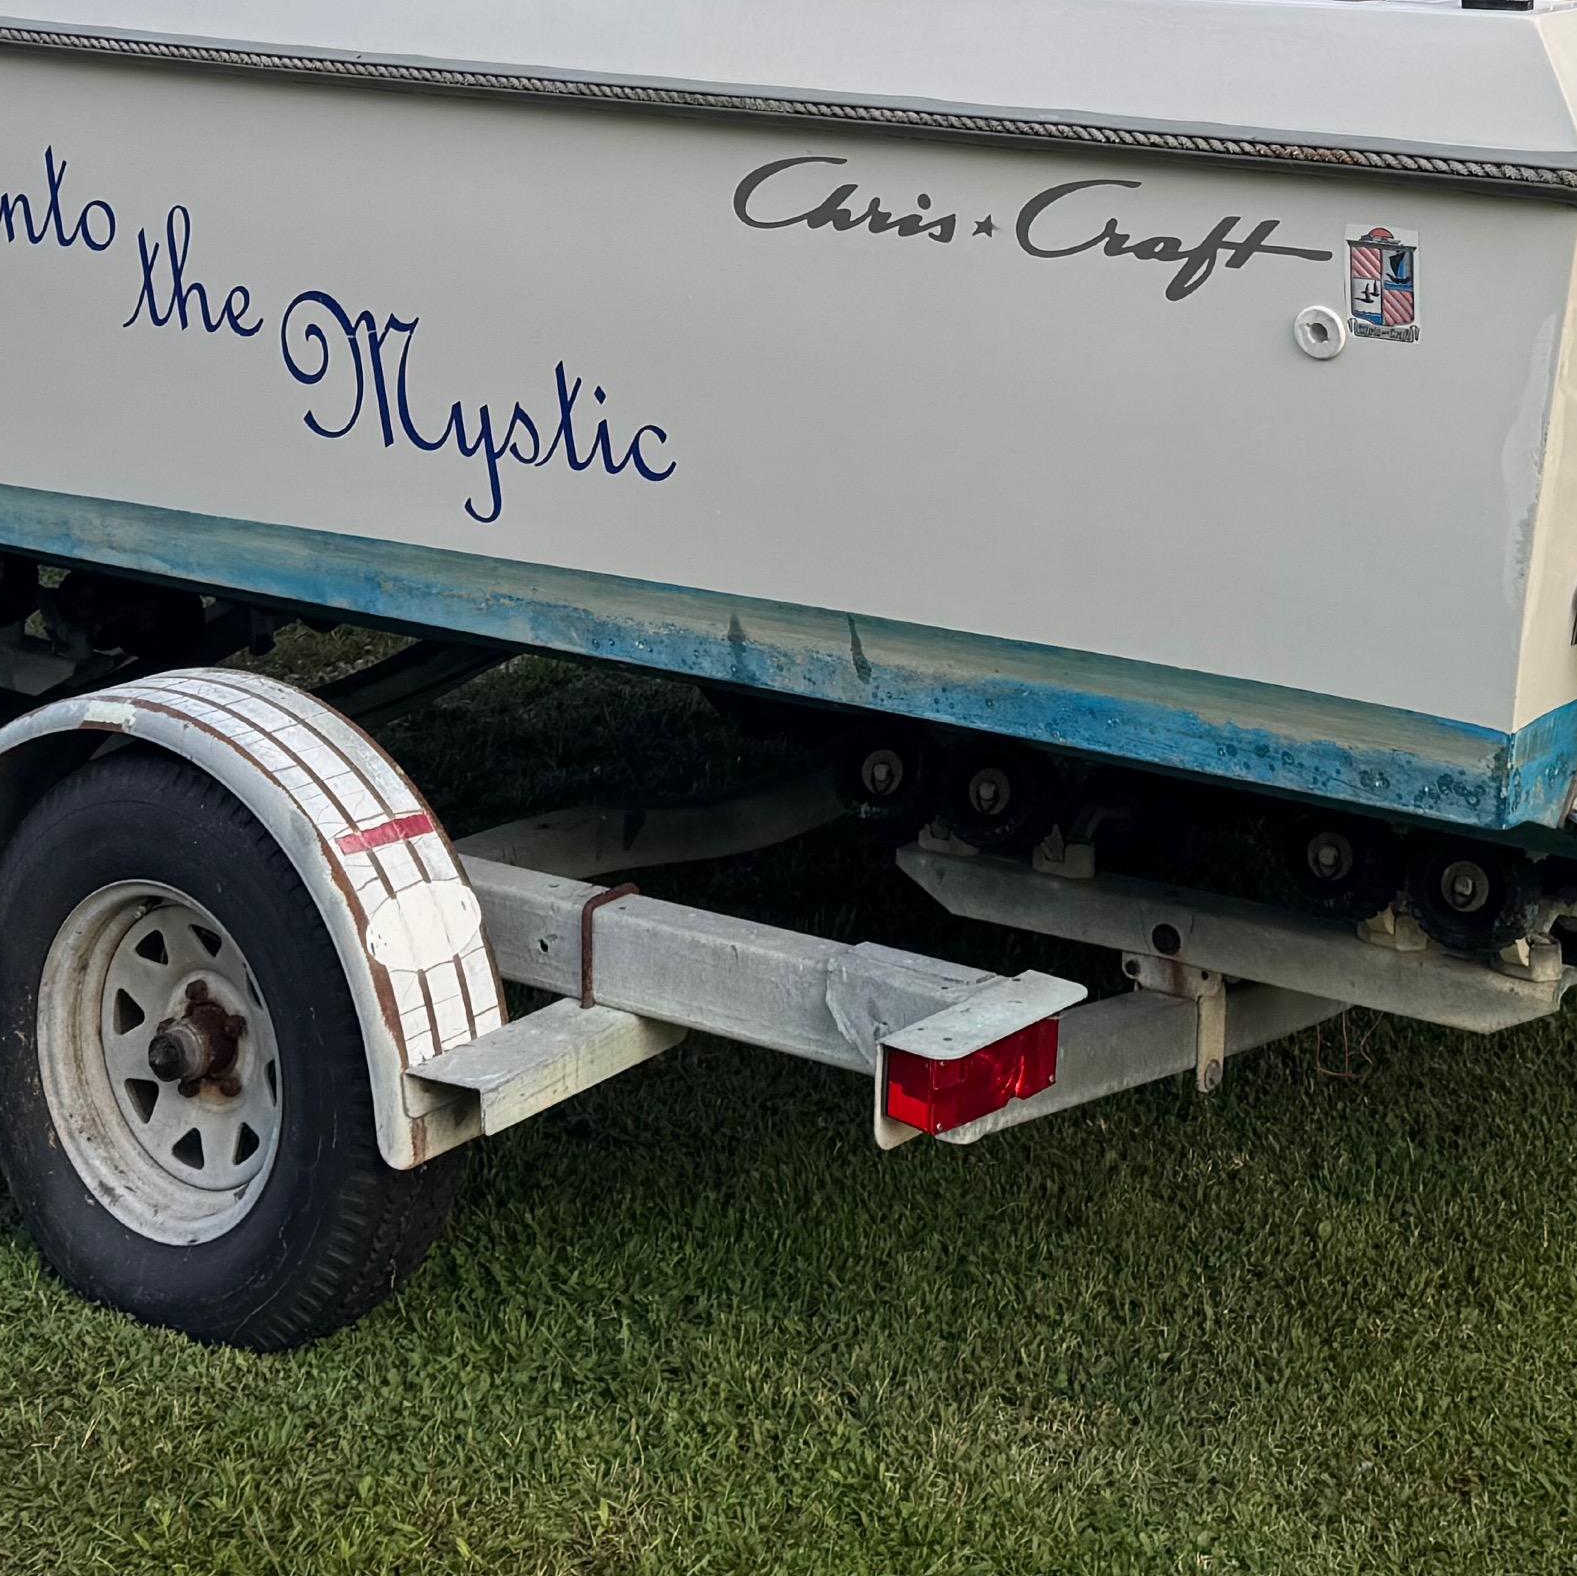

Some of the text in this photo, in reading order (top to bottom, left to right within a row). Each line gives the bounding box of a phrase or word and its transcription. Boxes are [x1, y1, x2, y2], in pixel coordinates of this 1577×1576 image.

[733, 156, 1333, 302] Chris Craft
[123, 205, 264, 338] the
[281, 290, 677, 524] Mystic
